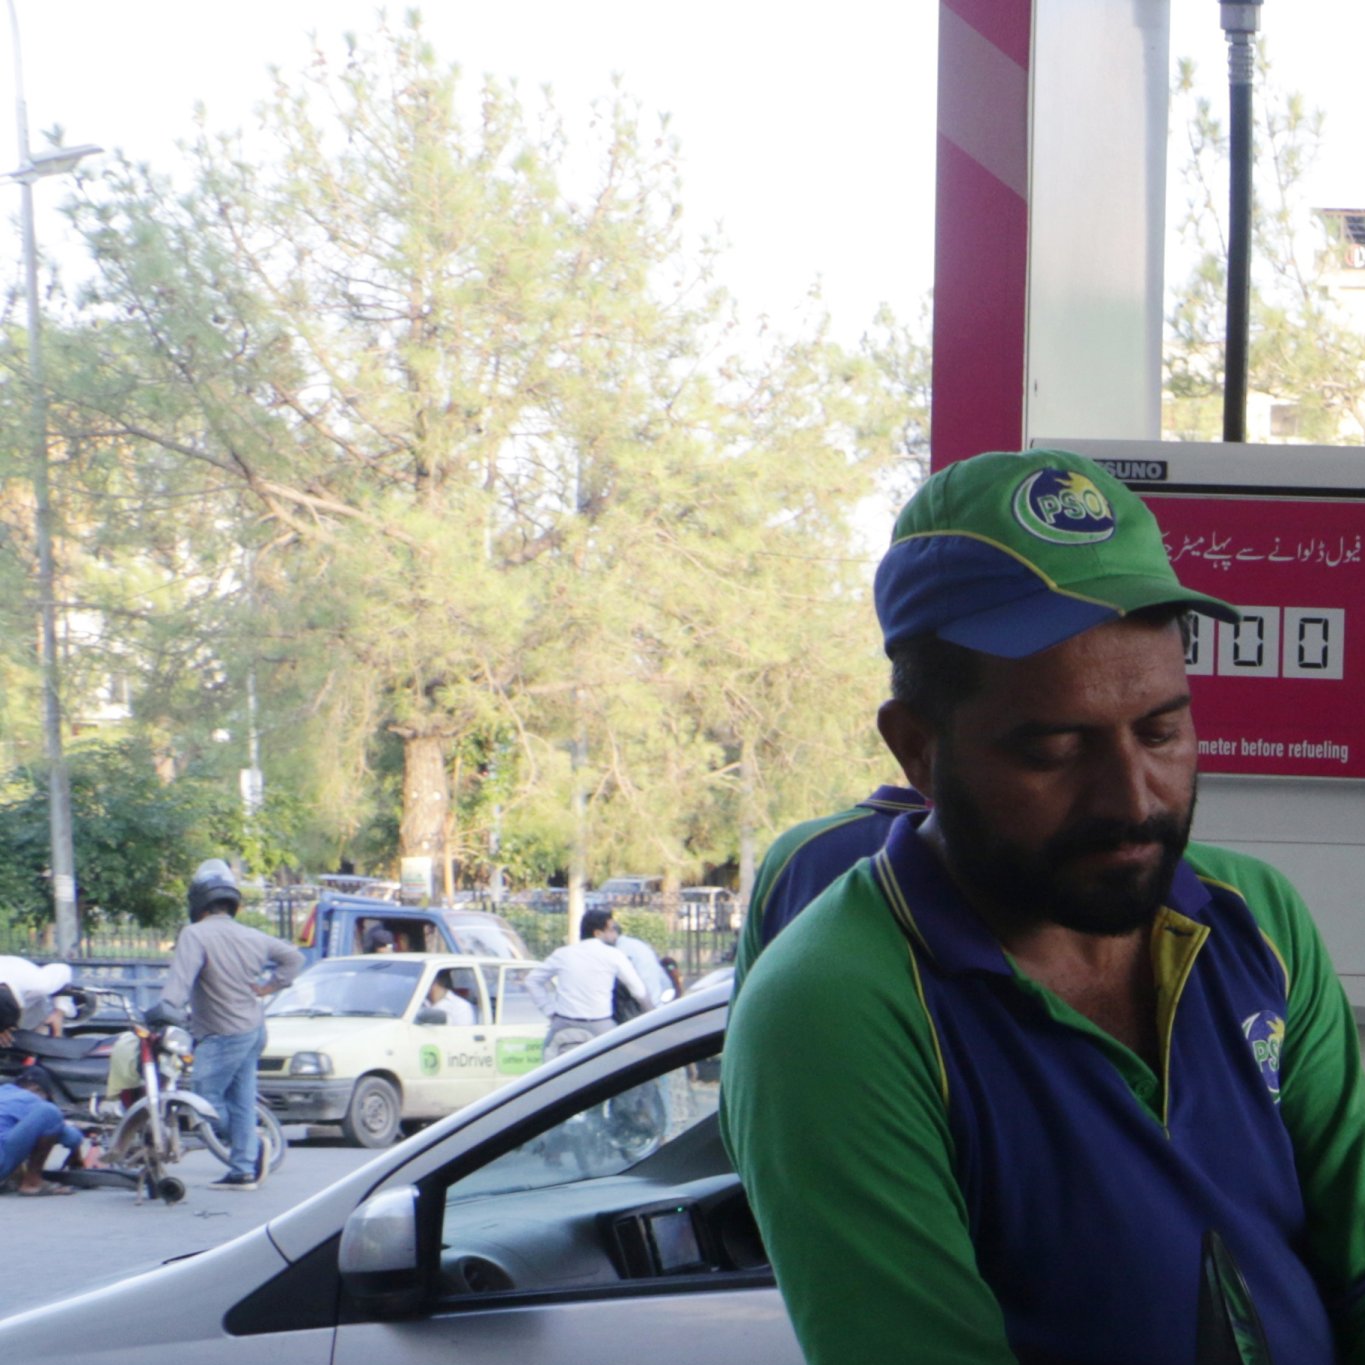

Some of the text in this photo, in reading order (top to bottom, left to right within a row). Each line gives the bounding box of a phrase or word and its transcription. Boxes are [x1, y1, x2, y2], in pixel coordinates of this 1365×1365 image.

[1036, 489, 1106, 524] PSO
[1198, 738, 1349, 764] meter before refueling
[447, 1051, 493, 1068] inDrive
[1252, 1039, 1281, 1074] PS
